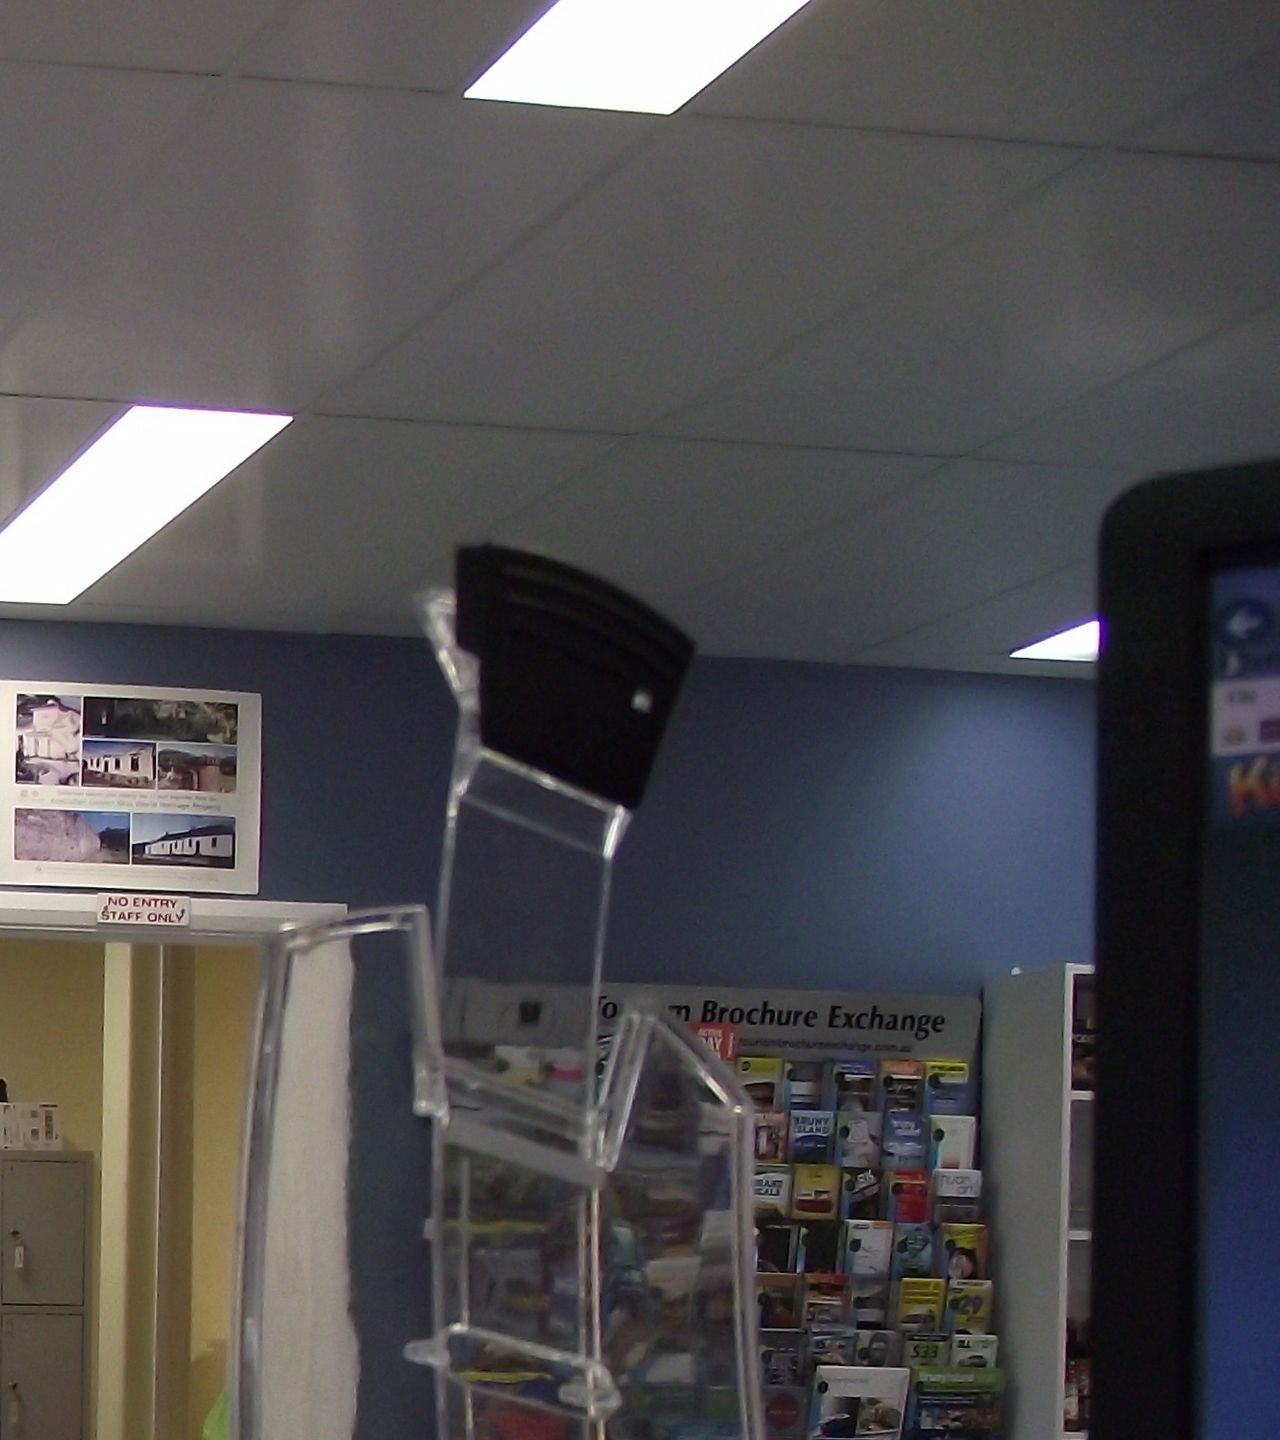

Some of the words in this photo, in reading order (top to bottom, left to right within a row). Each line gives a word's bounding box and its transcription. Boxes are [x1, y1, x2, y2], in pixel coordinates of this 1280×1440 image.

[108, 897, 128, 907] NO
[133, 898, 177, 909] ENTRY
[101, 910, 143, 921] STAFF
[147, 912, 184, 923] ONLY
[701, 1000, 818, 1028] Brochure
[828, 1005, 946, 1040] Exchange
